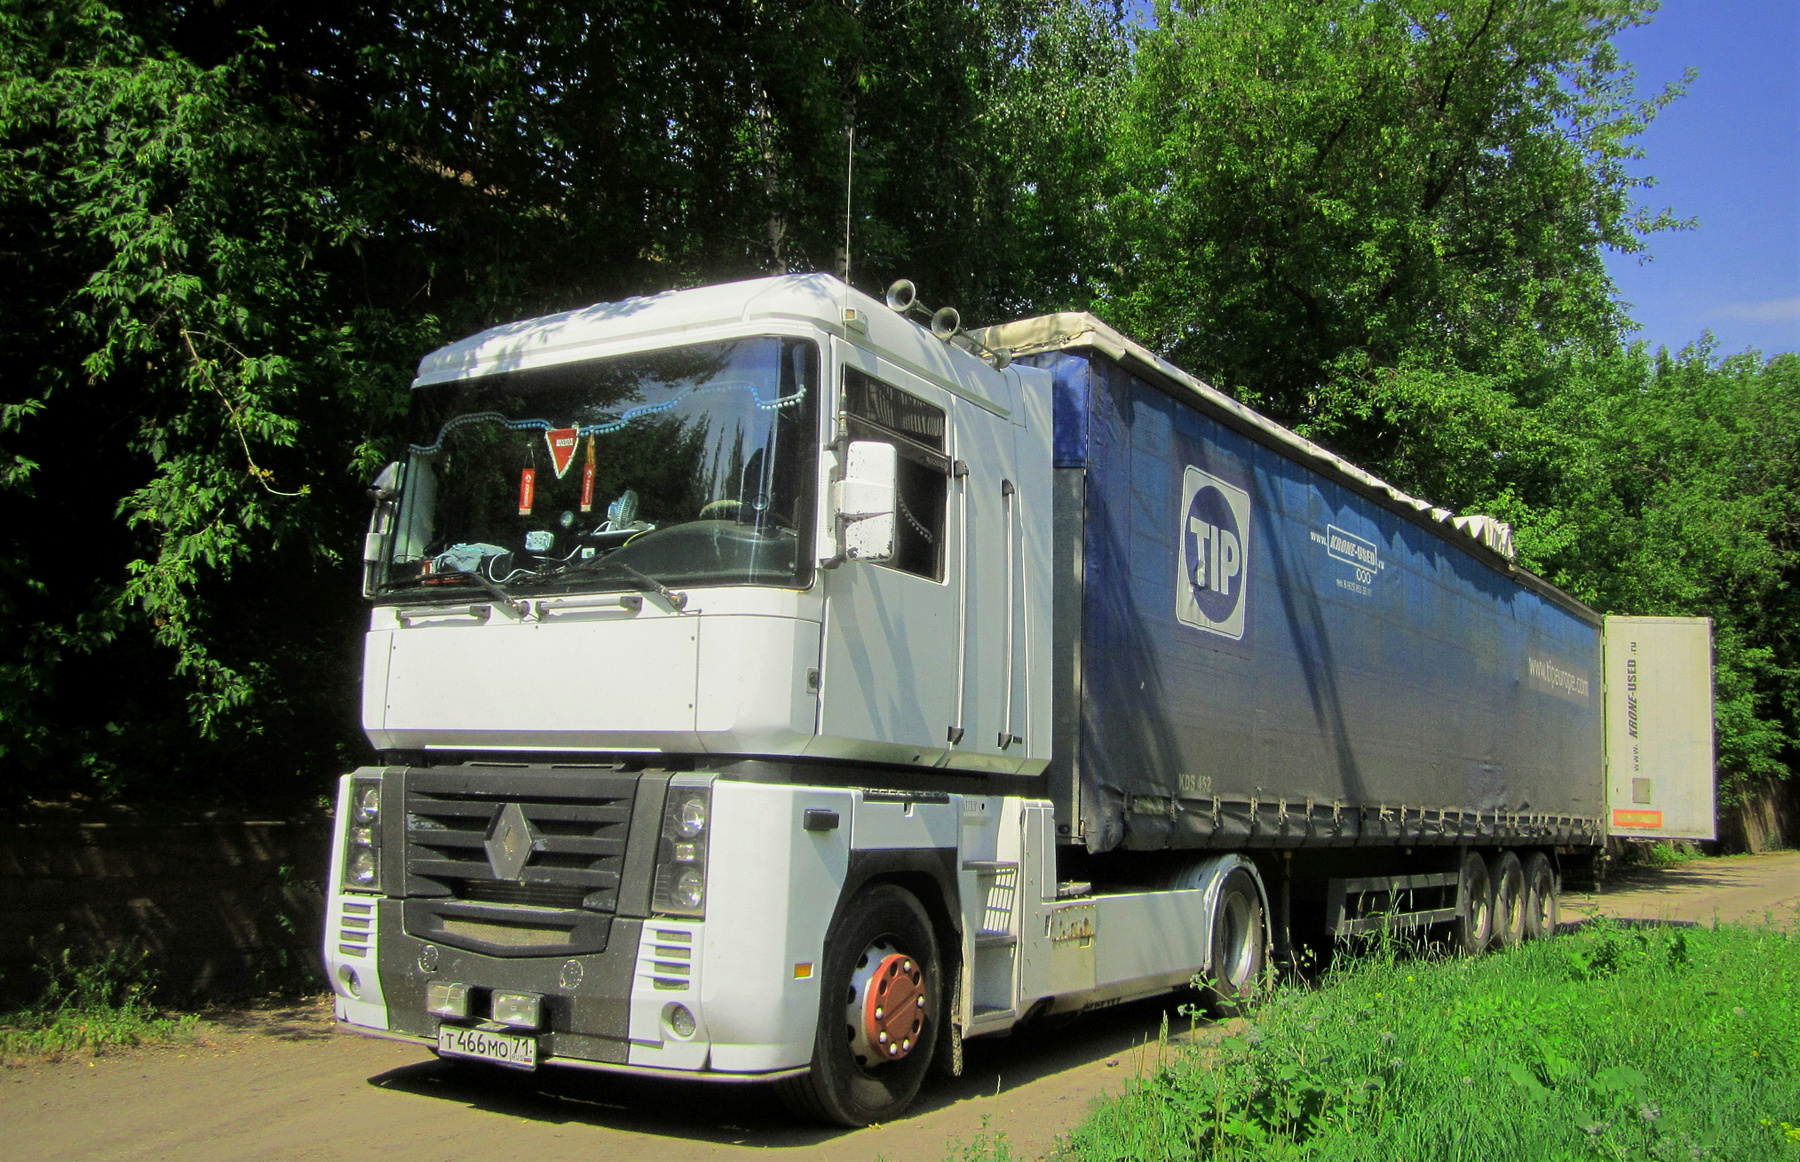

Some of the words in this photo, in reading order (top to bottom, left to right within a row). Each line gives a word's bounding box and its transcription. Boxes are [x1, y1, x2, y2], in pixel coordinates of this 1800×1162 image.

[1190, 516, 1240, 596] TIP
[1528, 657, 1589, 698] www.tipeurope.com
[1627, 659, 1639, 739] KRONE-USED
